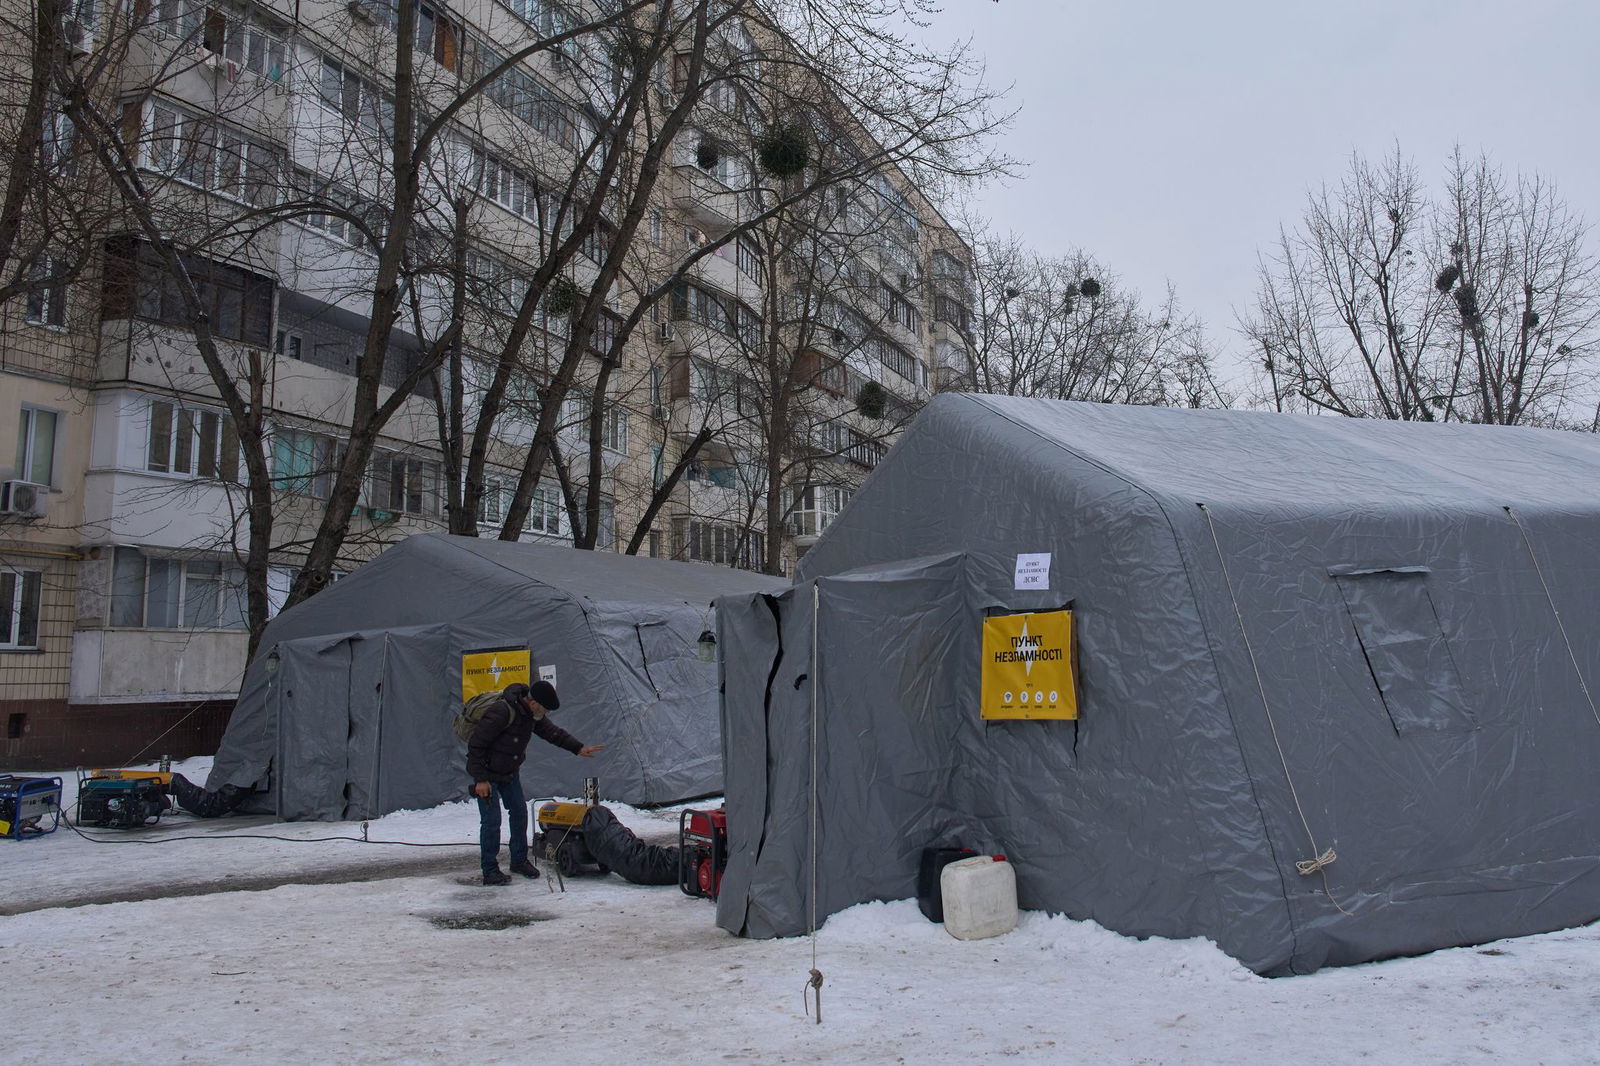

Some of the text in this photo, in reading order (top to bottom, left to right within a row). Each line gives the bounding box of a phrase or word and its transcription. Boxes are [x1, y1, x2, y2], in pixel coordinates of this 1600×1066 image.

[1010, 635, 1043, 648] ПУНКТ
[994, 648, 1062, 662] НЕЗЛАМНОСТІ
[487, 665, 527, 674] НЕЗЛАМНОСТІ
